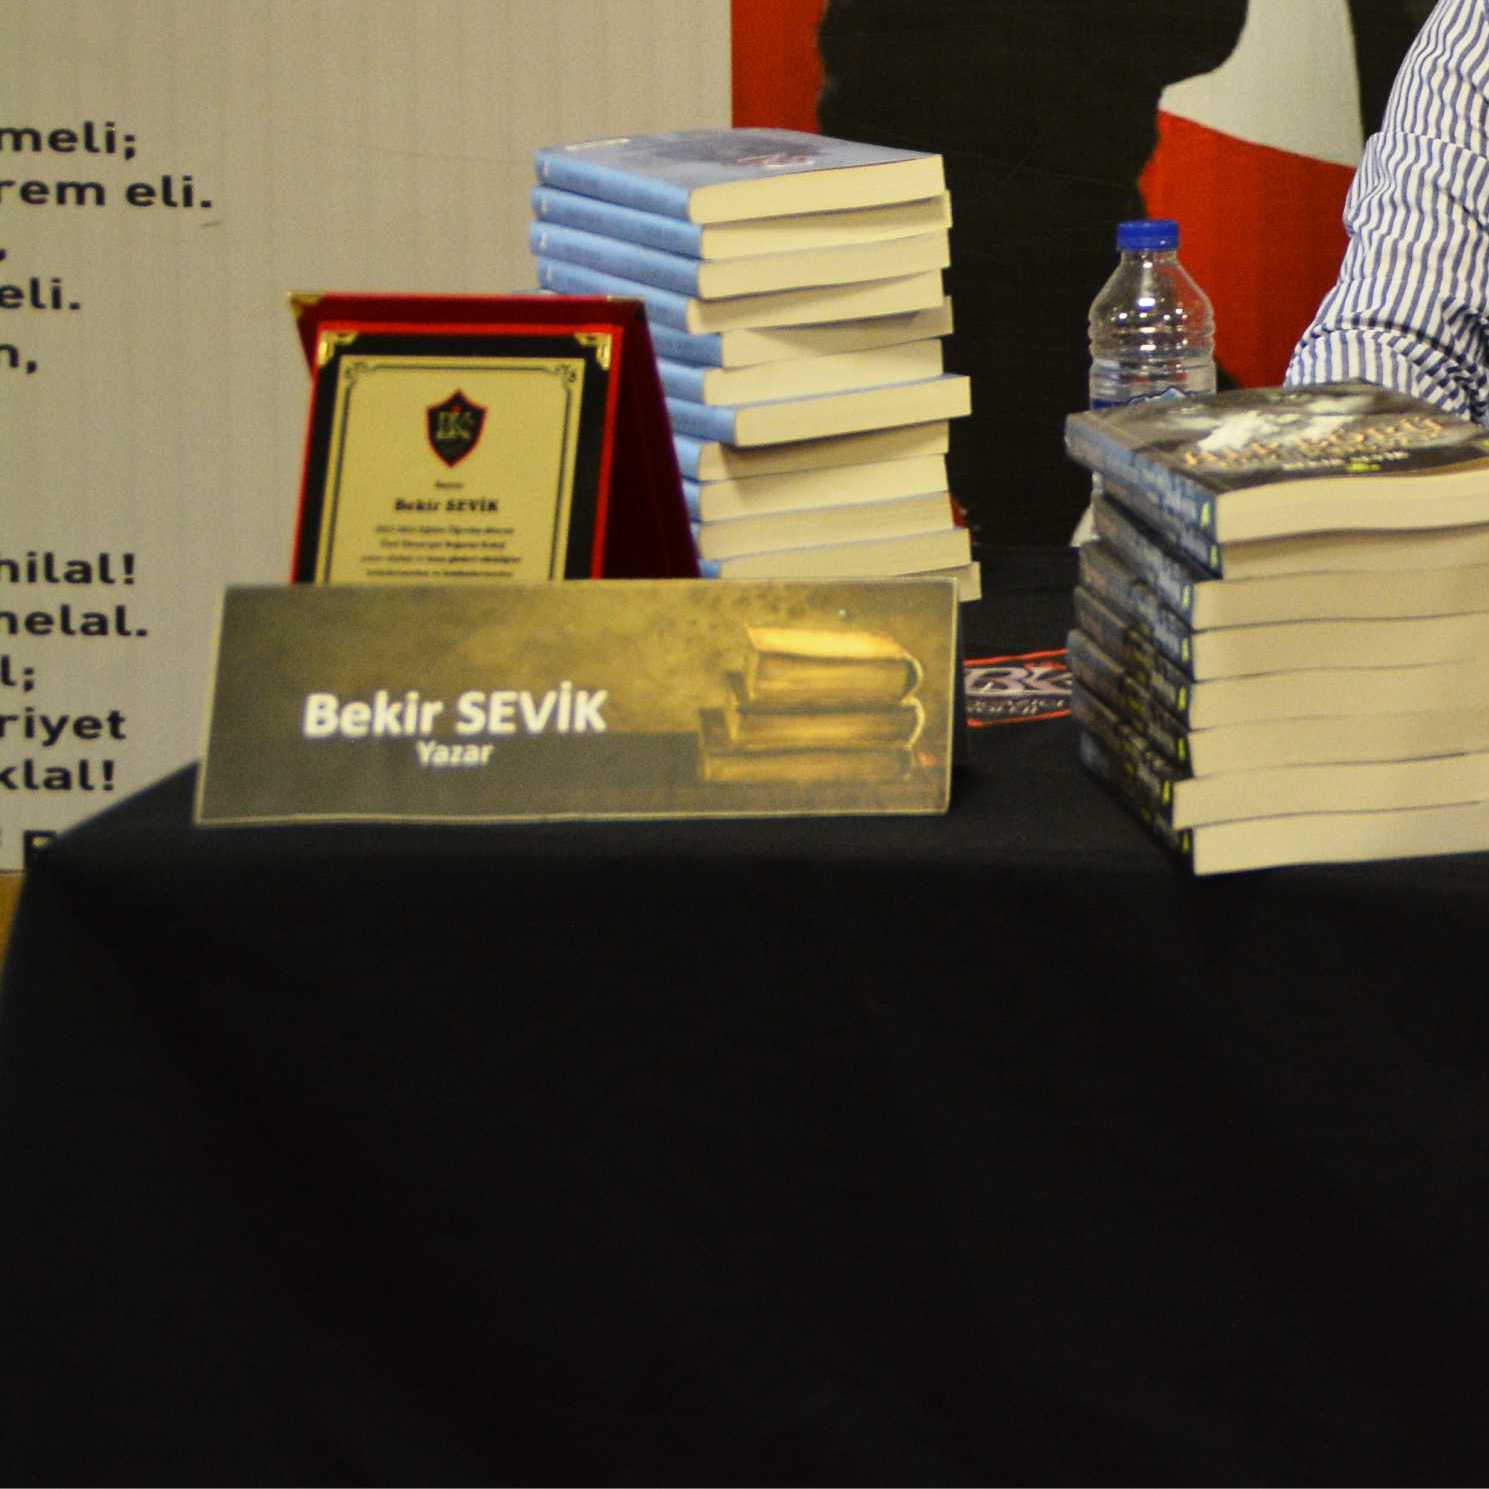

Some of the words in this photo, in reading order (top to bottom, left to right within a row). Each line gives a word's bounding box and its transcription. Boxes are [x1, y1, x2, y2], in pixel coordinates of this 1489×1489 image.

[0, 121, 136, 161] meli;
[125, 175, 213, 209] eli.
[0, 706, 127, 748] riyet
[303, 690, 442, 739] Bekir
[455, 679, 608, 736] SEVİK
[415, 739, 495, 769] Yazar
